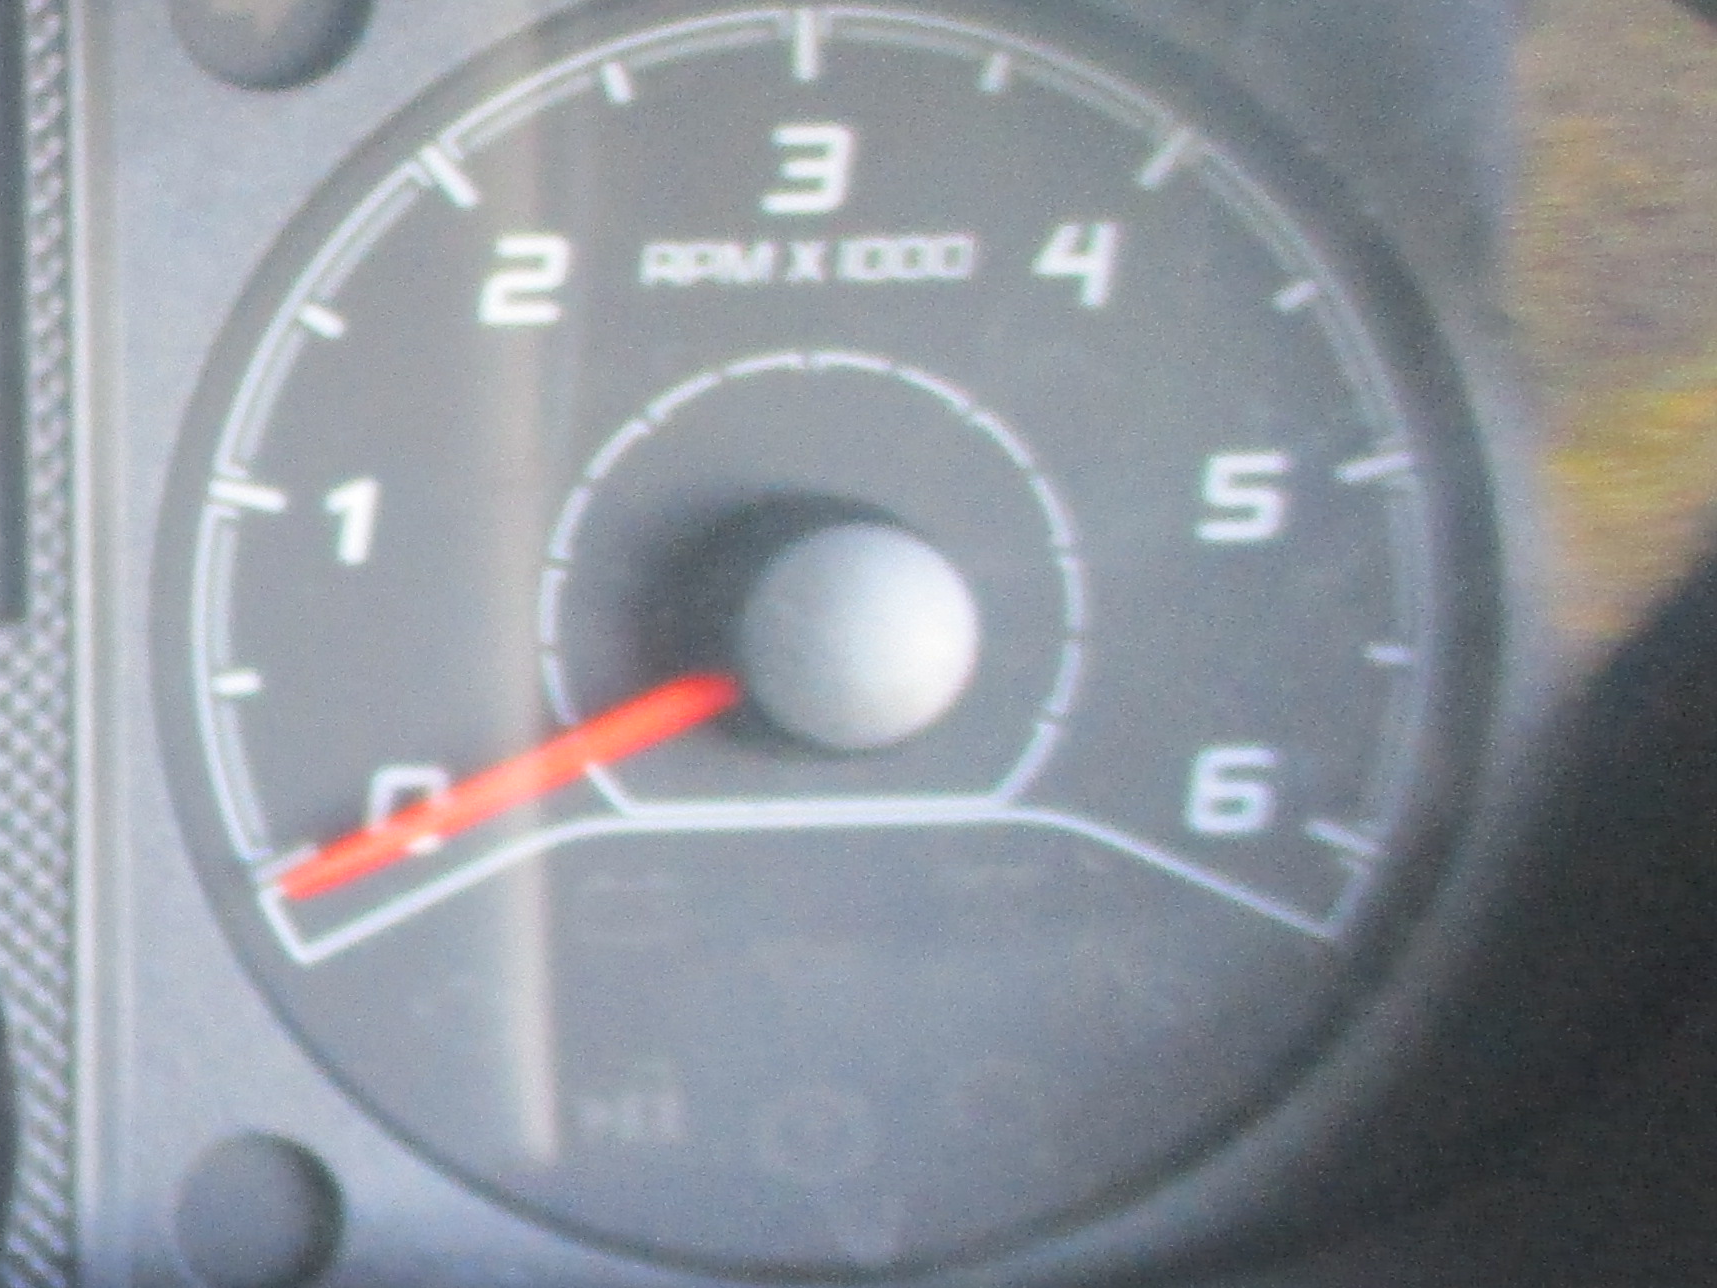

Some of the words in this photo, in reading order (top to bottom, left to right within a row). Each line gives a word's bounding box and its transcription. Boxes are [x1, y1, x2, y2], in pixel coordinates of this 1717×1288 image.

[765, 127, 850, 210] 3
[481, 239, 568, 322] 2
[641, 245, 774, 284] RPM
[839, 241, 972, 279] 1000
[1035, 227, 1113, 304] 4
[326, 482, 376, 562] 1
[1200, 455, 1291, 540] 5
[1187, 751, 1276, 832] 6
